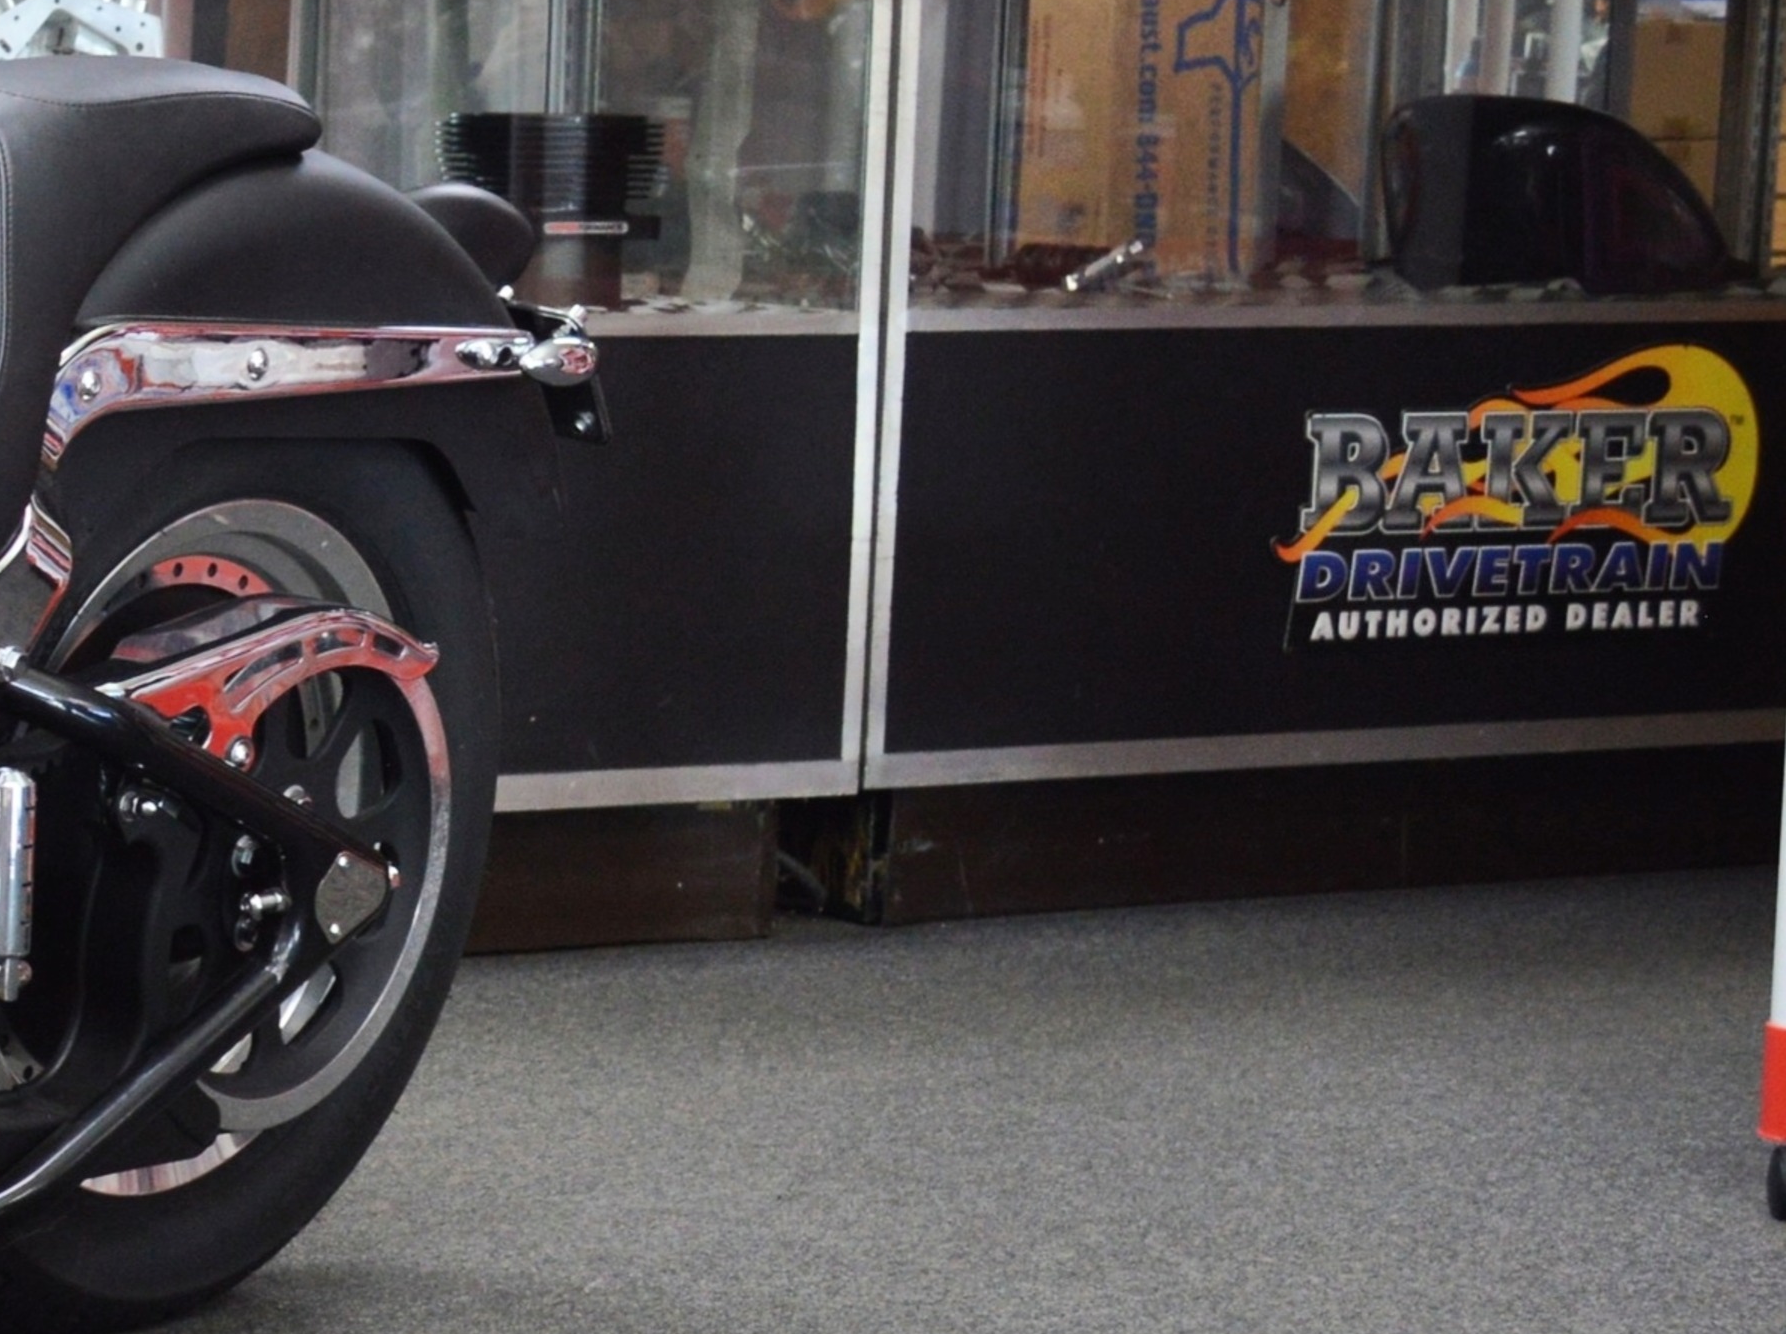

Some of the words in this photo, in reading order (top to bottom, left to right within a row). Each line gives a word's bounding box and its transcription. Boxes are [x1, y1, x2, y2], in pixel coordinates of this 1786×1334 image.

[1299, 409, 1734, 536] BAKER
[1295, 541, 1726, 603] DRIVETRAIN
[1309, 604, 1547, 642] AUTHORIZED
[1565, 600, 1700, 631] DEALER
